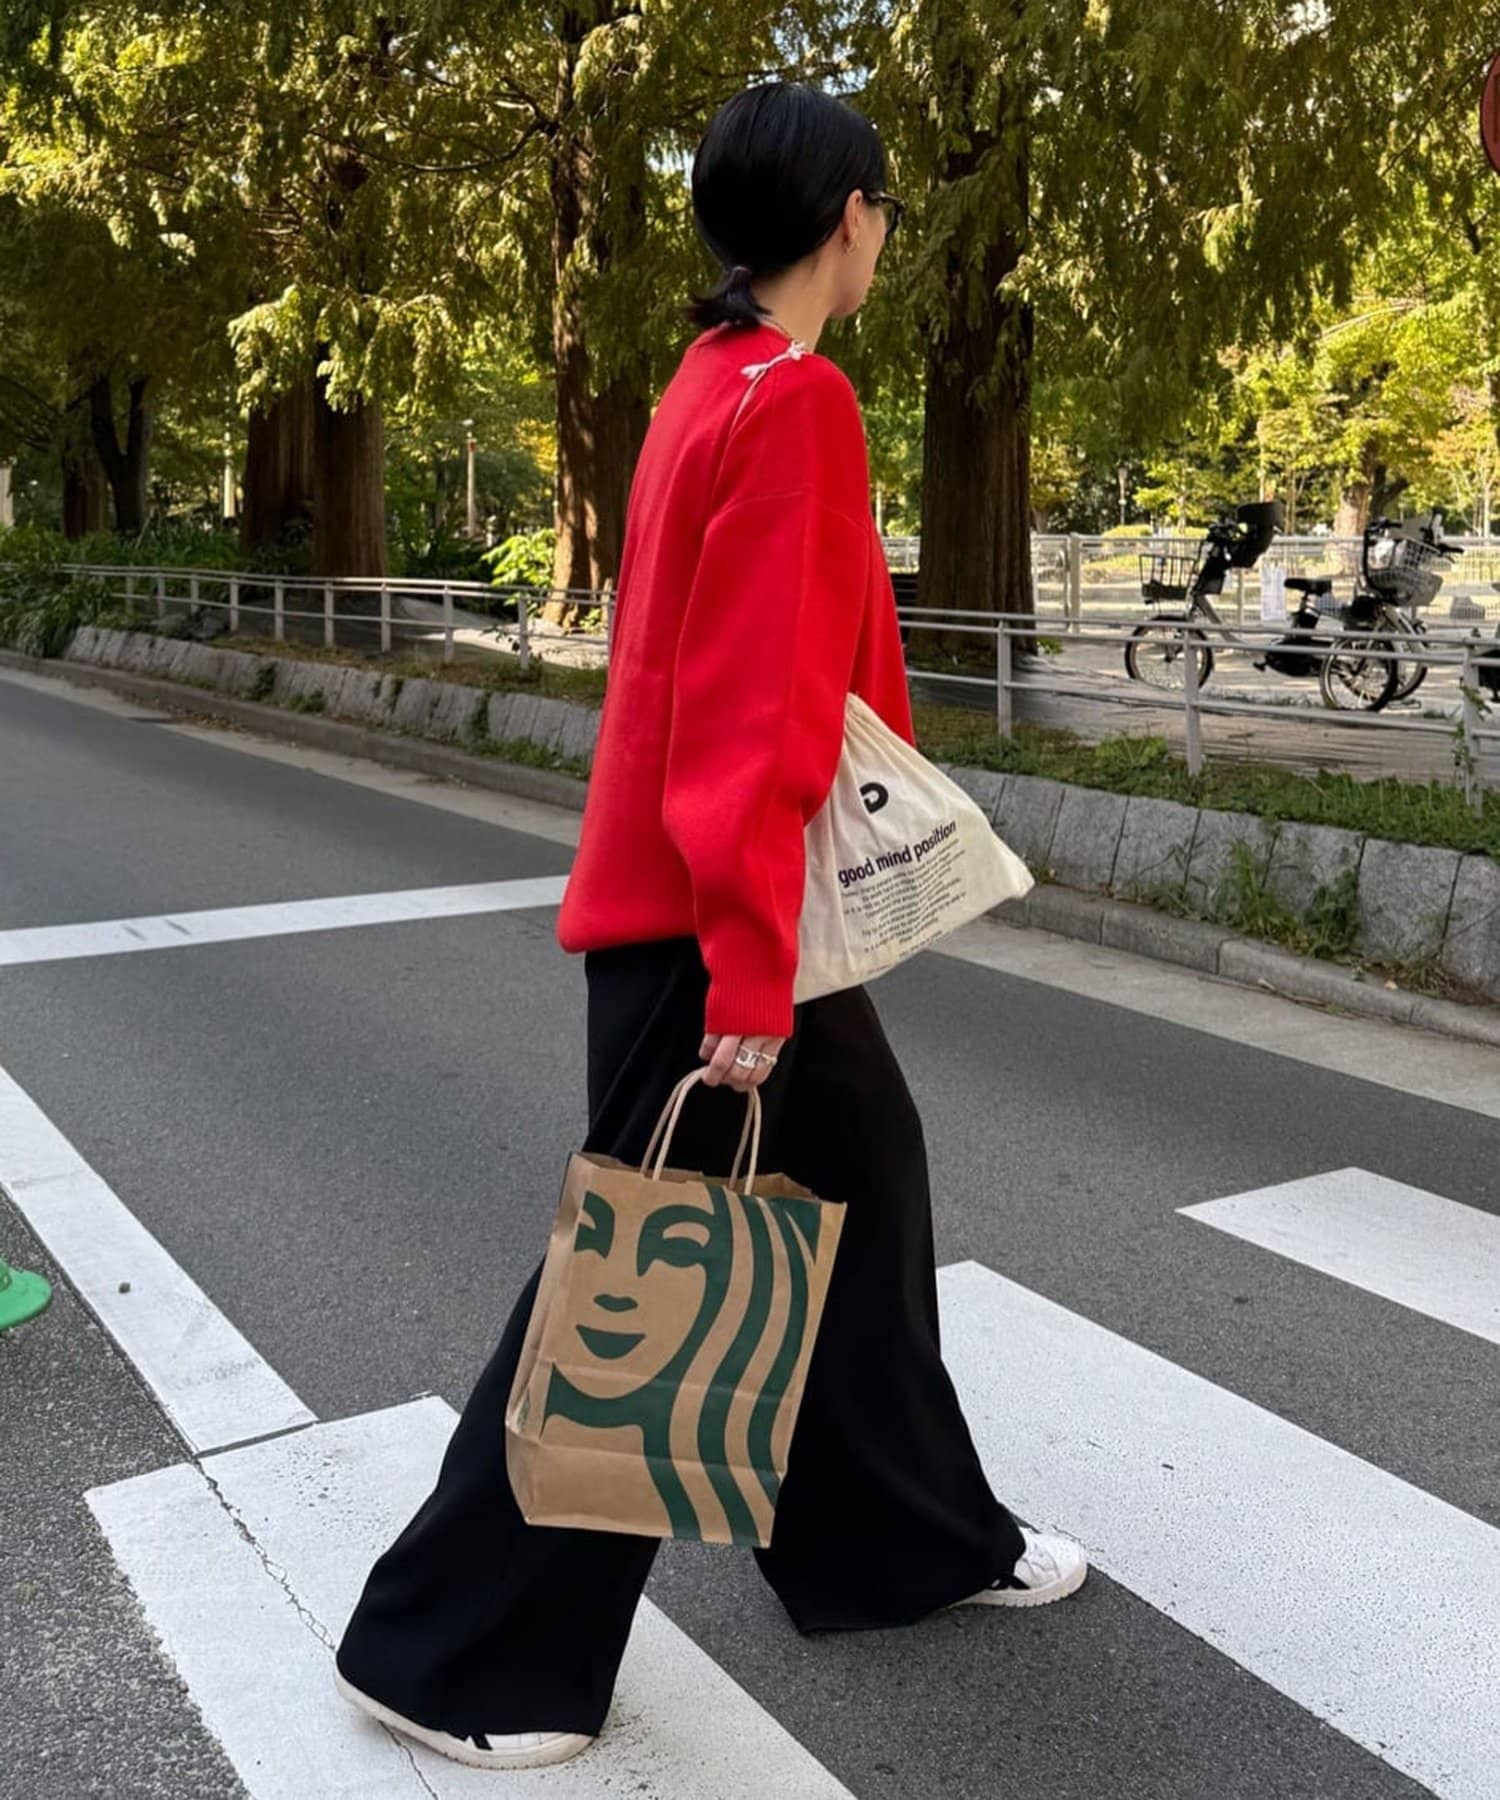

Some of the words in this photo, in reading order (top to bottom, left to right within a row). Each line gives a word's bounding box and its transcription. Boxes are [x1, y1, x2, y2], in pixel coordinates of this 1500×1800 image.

[838, 858, 875, 888] good
[876, 845, 912, 871] mind
[914, 820, 956, 861] position
